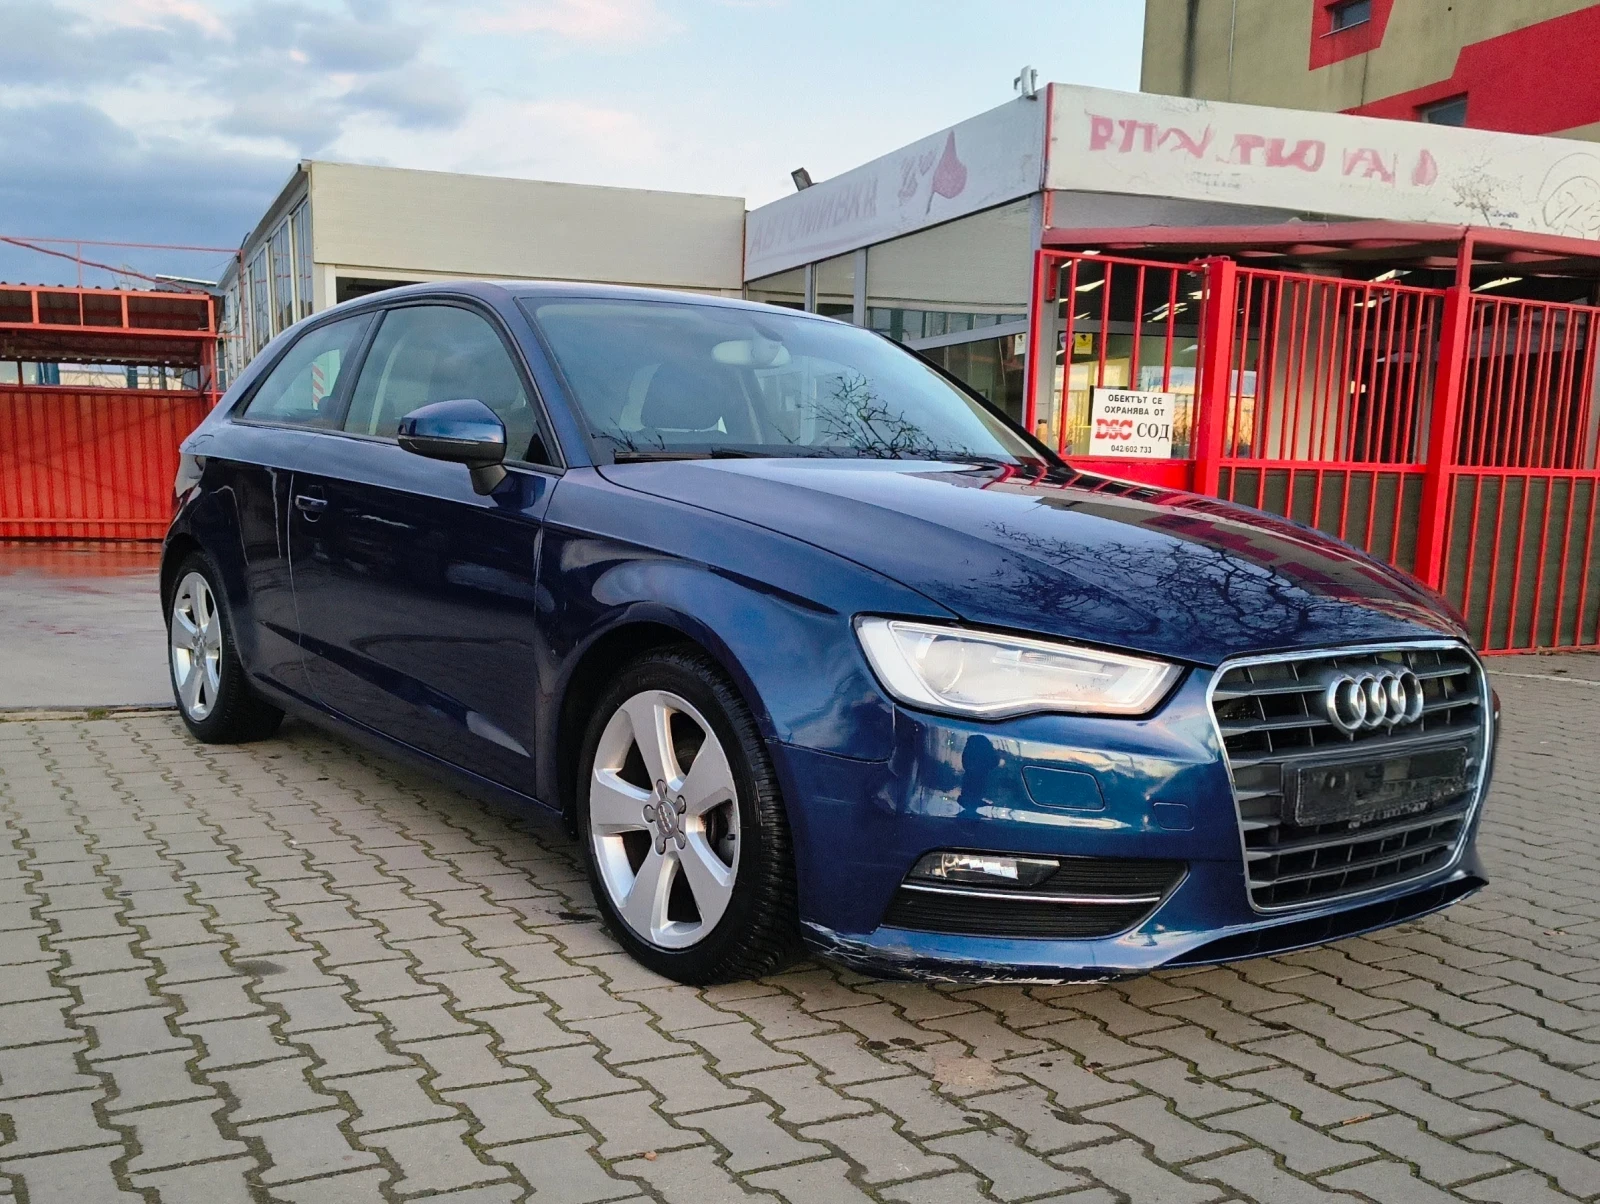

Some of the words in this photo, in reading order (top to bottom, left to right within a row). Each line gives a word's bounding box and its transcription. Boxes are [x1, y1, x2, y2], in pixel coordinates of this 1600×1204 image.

[1108, 394, 1147, 403] ОБЕКТЪТ
[1104, 405, 1149, 415] ОХРАНЯВА
[1154, 408, 1164, 416] ОТ
[1095, 419, 1133, 440] DSC
[1136, 422, 1170, 442] СОД
